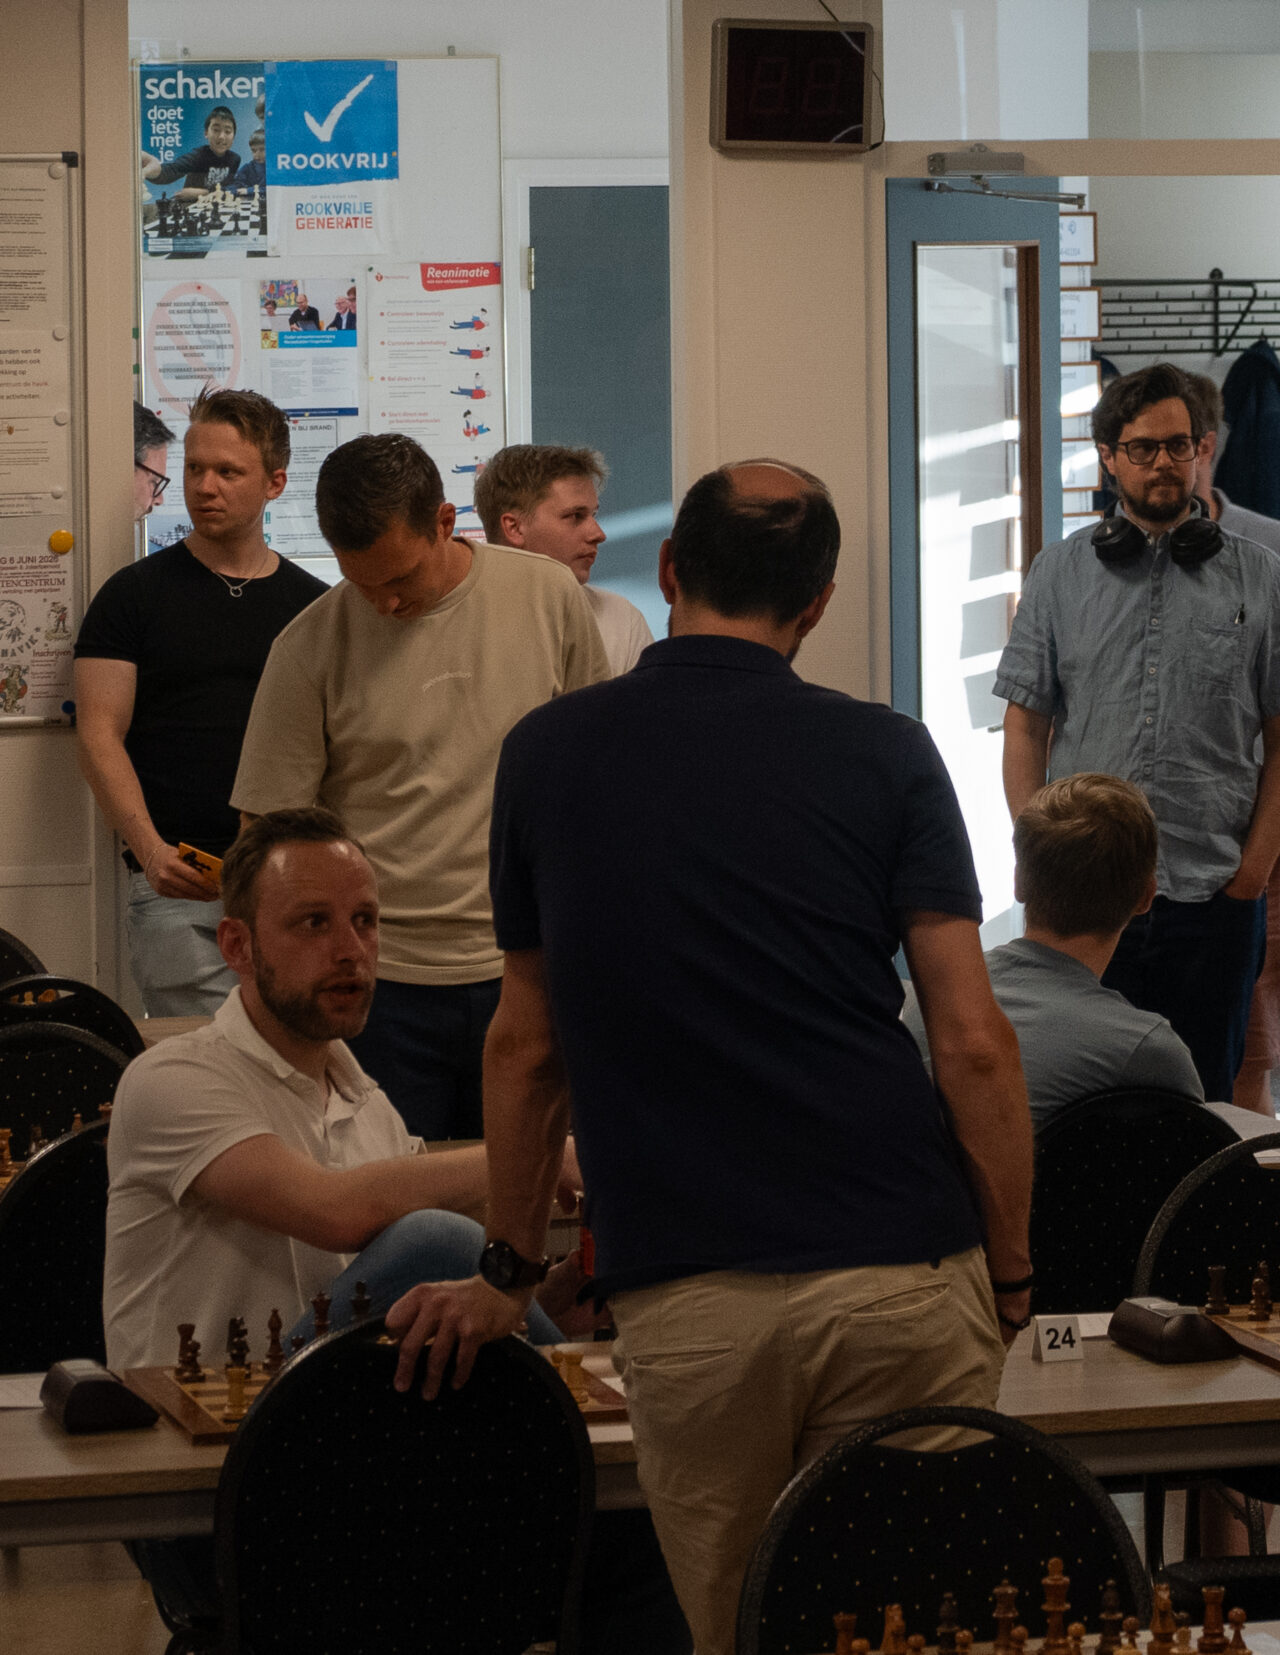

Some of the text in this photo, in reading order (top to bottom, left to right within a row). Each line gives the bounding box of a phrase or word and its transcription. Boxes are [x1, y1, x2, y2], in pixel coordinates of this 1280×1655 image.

[147, 105, 184, 120] doet
[151, 120, 180, 134] iets
[150, 134, 182, 147] met
[158, 147, 175, 164] je
[277, 152, 388, 170] ROOKVRIJ
[295, 202, 373, 216] ROOKVRIJE
[295, 216, 373, 231] GENERATIE
[426, 266, 490, 278] Reanimatie
[17, 556, 37, 564] JUNI
[0, 578, 66, 588] TENCENTRUM
[1045, 1326, 1076, 1350] 24
